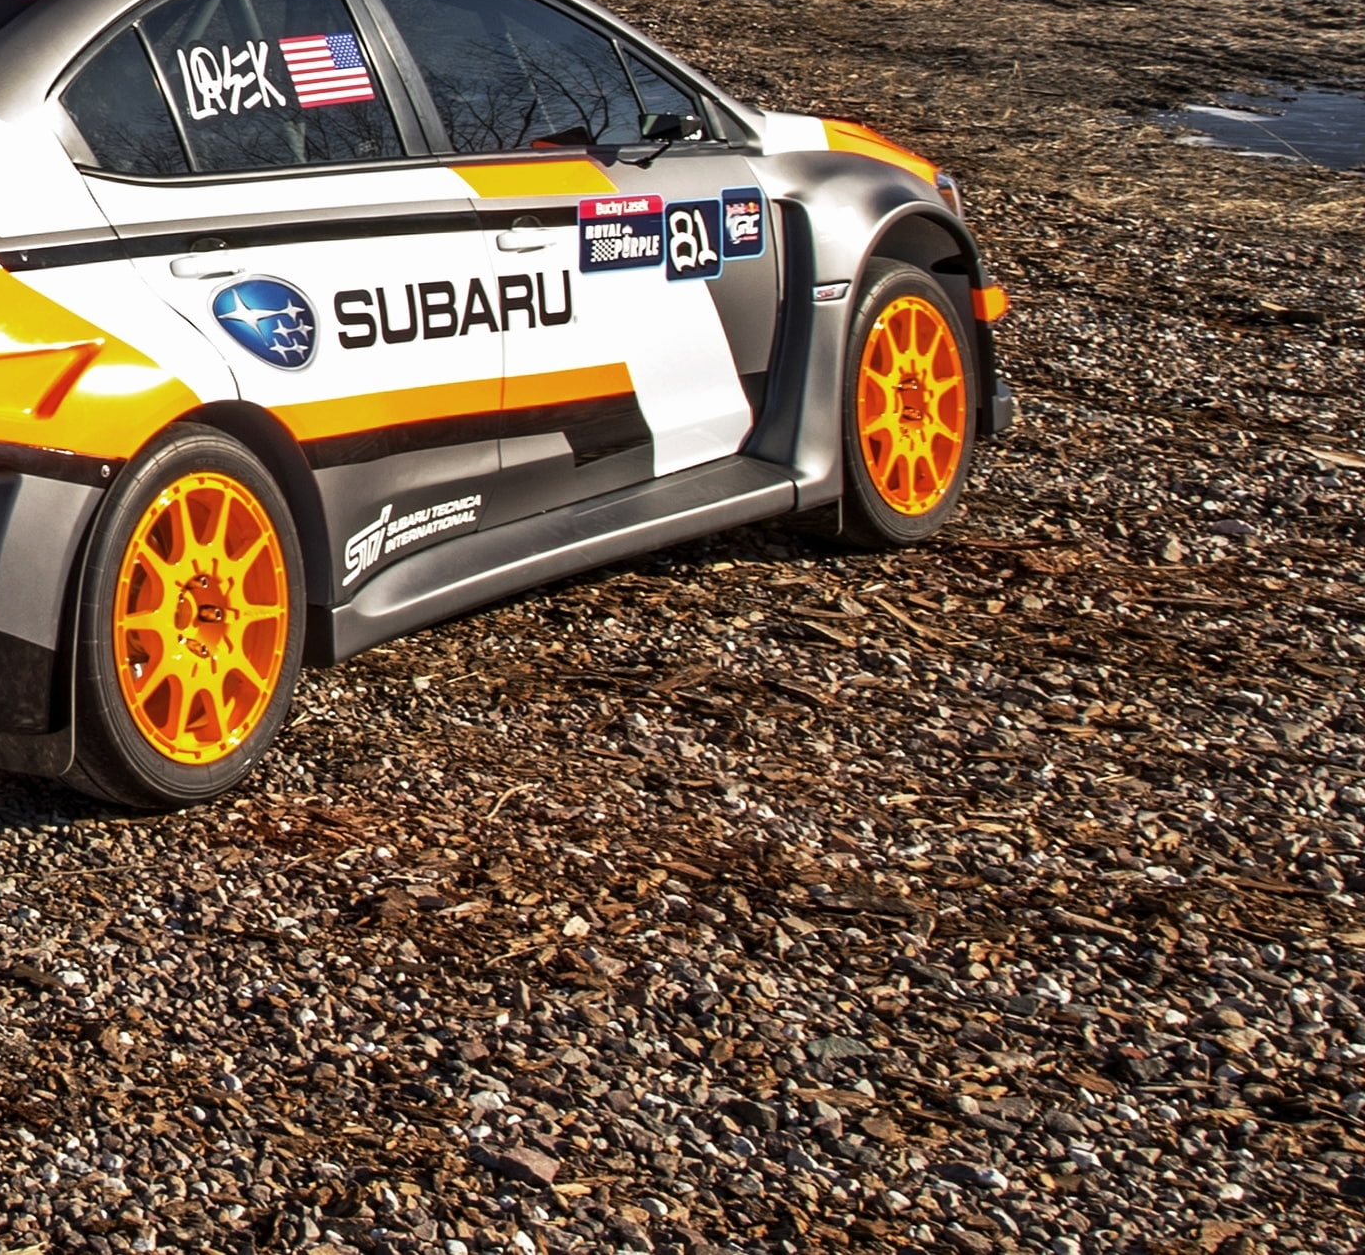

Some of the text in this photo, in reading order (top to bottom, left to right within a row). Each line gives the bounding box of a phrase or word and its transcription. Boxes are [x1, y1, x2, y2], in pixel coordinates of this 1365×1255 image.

[595, 199, 649, 216] Bucky Lasek
[585, 223, 622, 239] ROYAL
[613, 234, 660, 260] PURPLE
[668, 209, 717, 273] 81
[333, 270, 573, 349] SUBARU
[384, 509, 477, 554] INTERNATIONAL
[386, 494, 482, 537] SUBARU TECNICA
